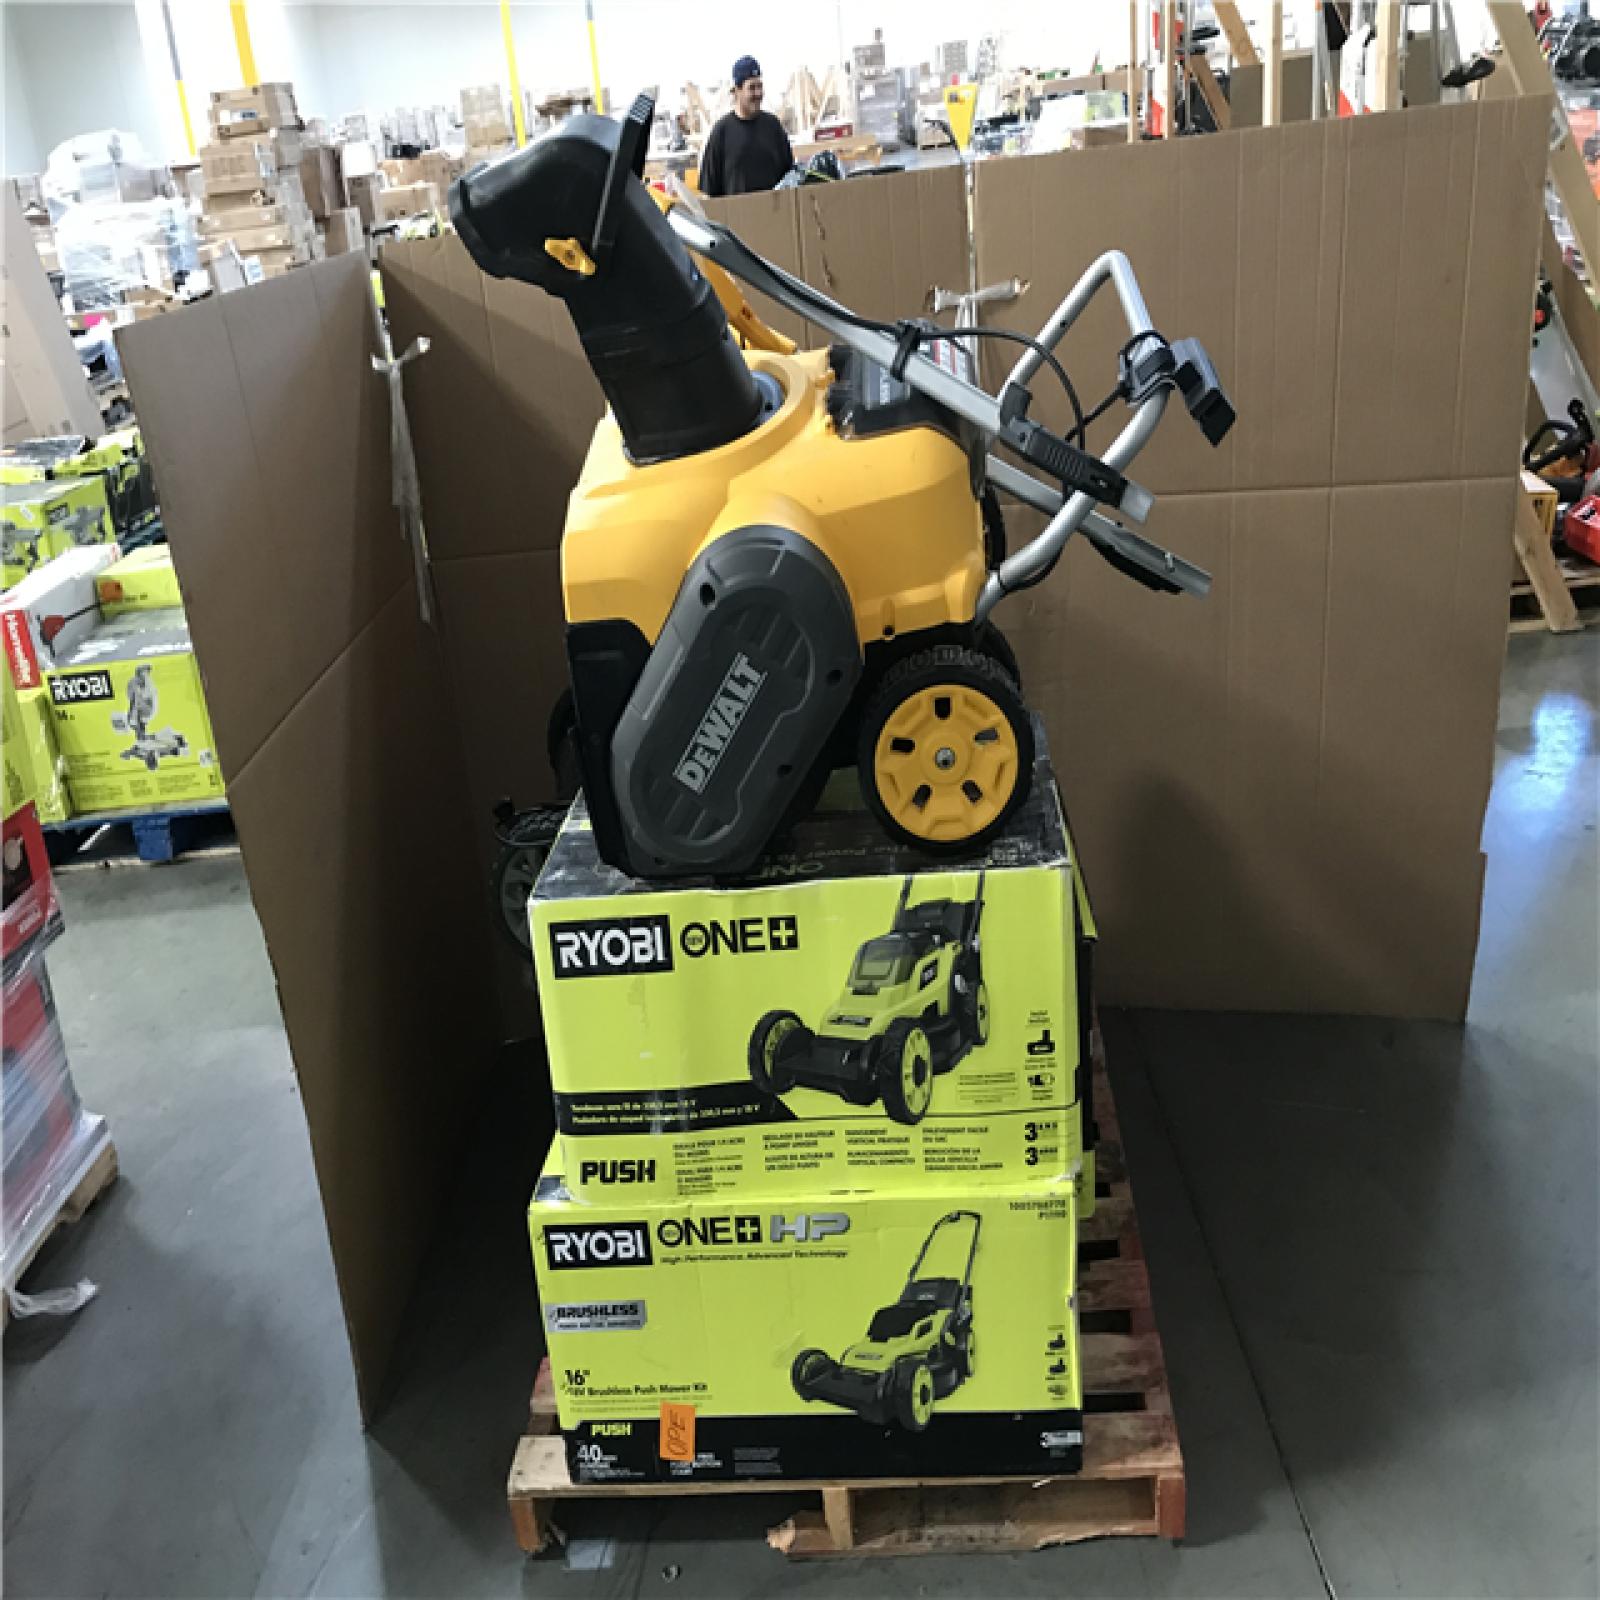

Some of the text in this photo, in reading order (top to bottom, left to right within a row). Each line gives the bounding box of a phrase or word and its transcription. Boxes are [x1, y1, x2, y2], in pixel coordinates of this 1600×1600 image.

[50, 675, 110, 700] RYOBI
[555, 926, 666, 968] RYOBI
[1024, 1122, 1038, 1141] 3
[1024, 1147, 1038, 1166] 3
[580, 1160, 656, 1184] PUSH
[769, 1212, 850, 1242] HP
[549, 1229, 646, 1263] RYOBI
[557, 1303, 638, 1318] BRUSHLESS
[588, 1386, 631, 1396] Brushless
[634, 1384, 657, 1395] Push
[659, 1384, 691, 1393] Mower
[692, 1382, 708, 1391] Kit
[591, 1423, 632, 1436] PUSH
